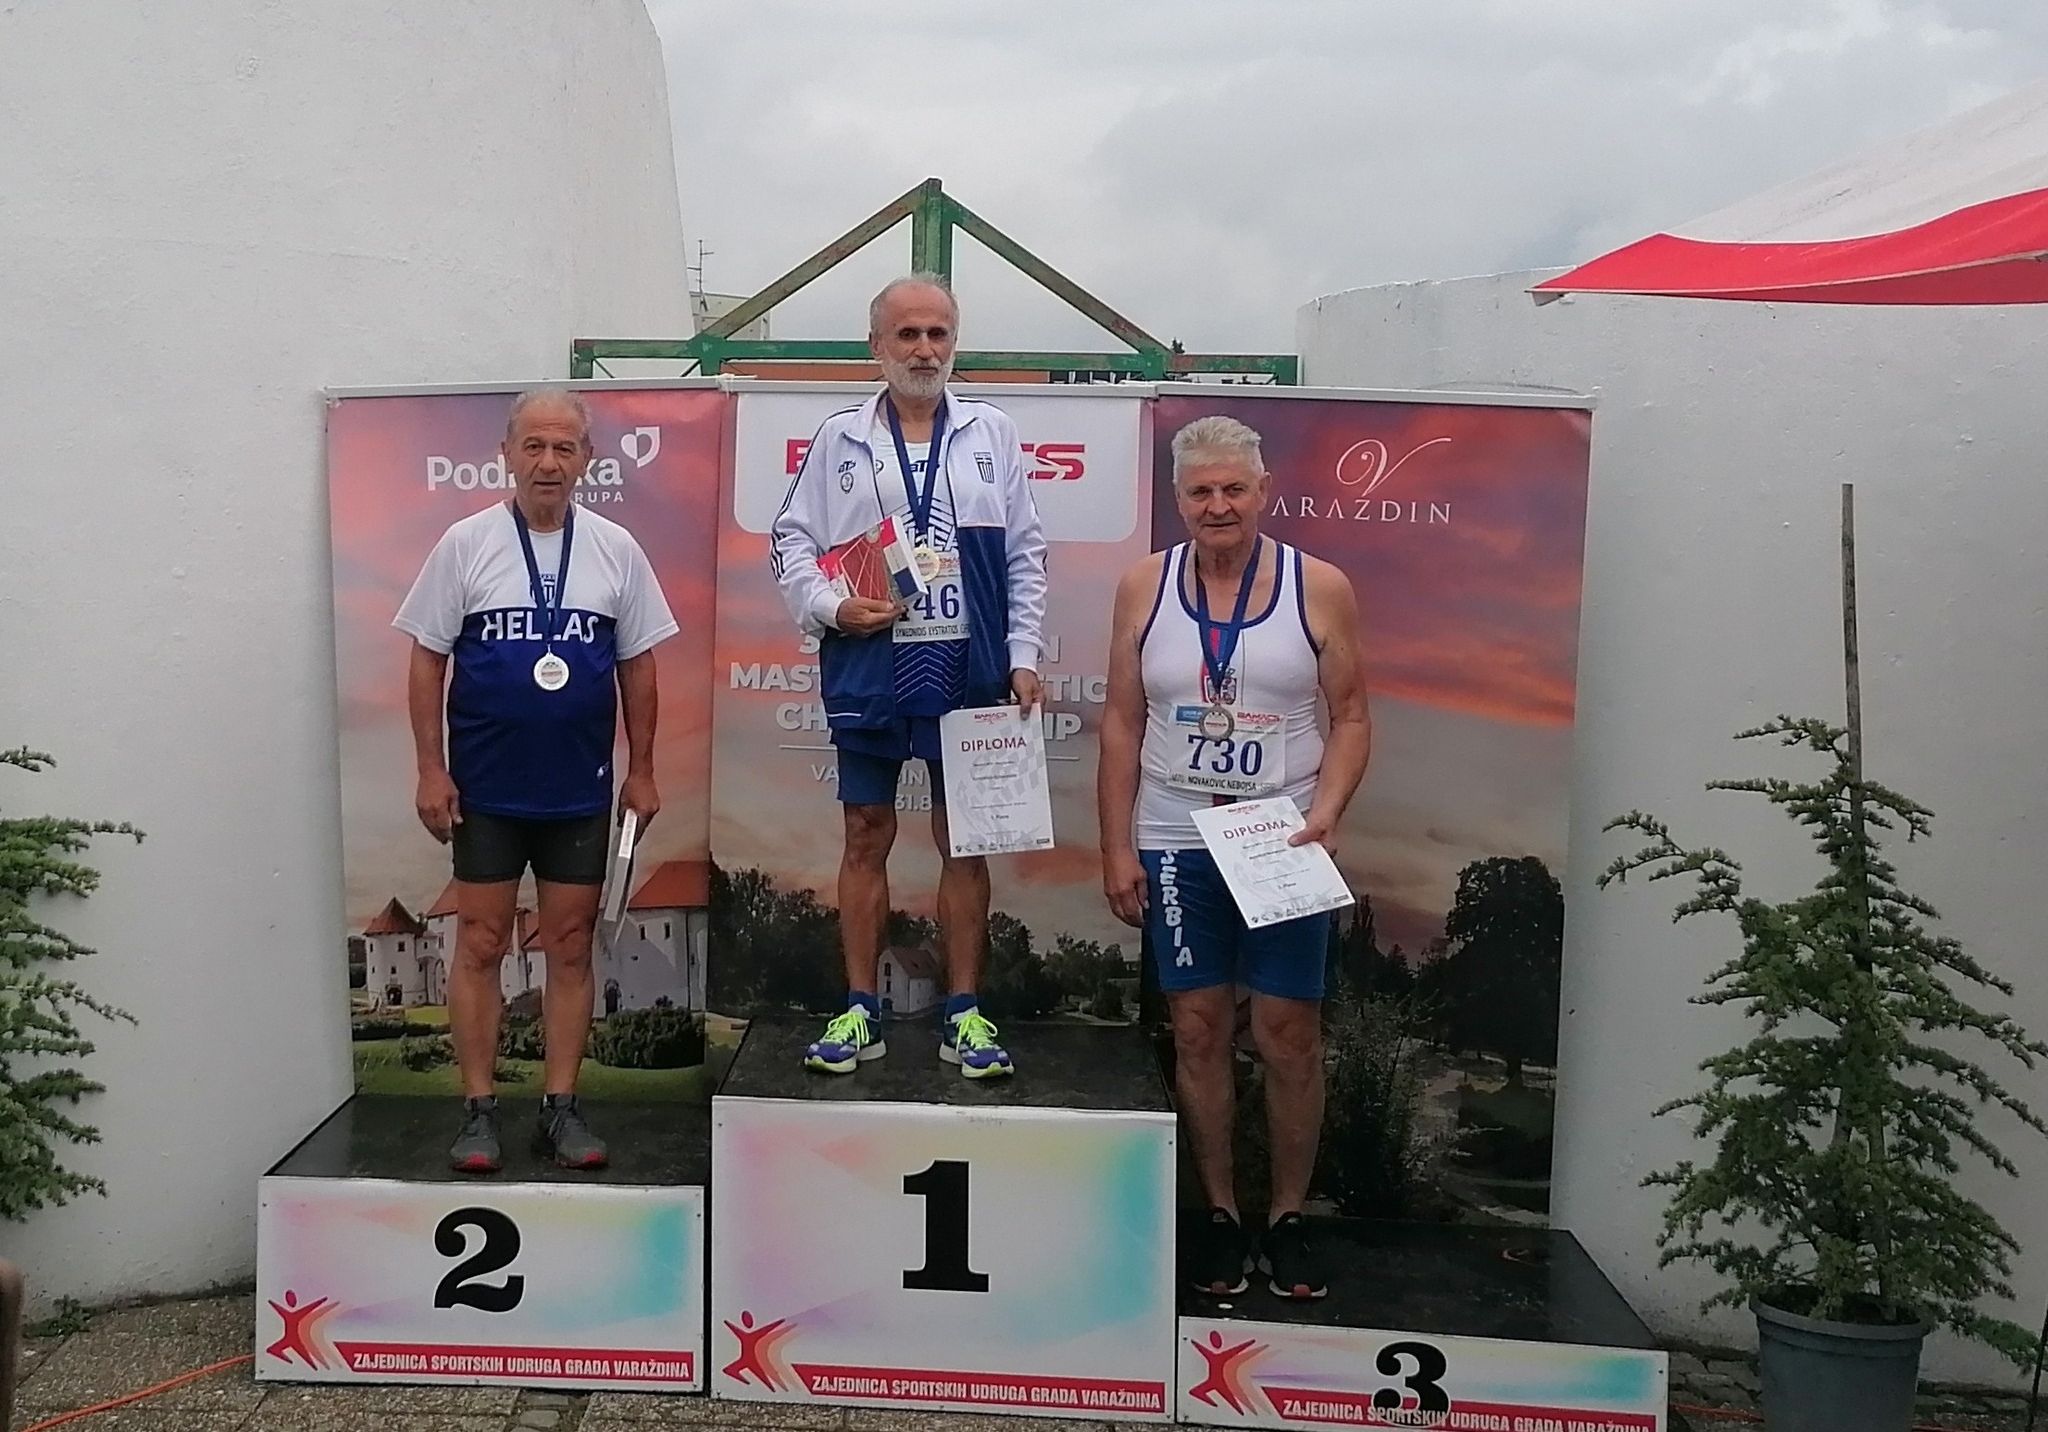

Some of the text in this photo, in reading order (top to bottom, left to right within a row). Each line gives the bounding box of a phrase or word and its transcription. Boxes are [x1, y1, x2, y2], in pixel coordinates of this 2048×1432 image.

[574, 491, 624, 503] RUPA
[961, 736, 1027, 752] DIPLOMA
[1188, 733, 1263, 777] 730
[1223, 819, 1291, 839] DIPLOMA
[1159, 849, 1194, 968] SERBIA
[901, 1159, 990, 1293] 1
[433, 1205, 526, 1313] 2
[353, 1353, 690, 1378] ZAJEDNICA SPORTSKIH UDRUGA GRADA VARAŽDINA
[811, 1376, 1160, 1409] ZAJEDNICA SPORTSKIH UDRUGA GRADA VARAŽDINA
[1371, 1340, 1452, 1428] 3
[1283, 1399, 1363, 1421] ZAJEDNICA
[1451, 1411, 1510, 1431] UDRUGA
[1514, 1416, 1564, 1432] GRADA
